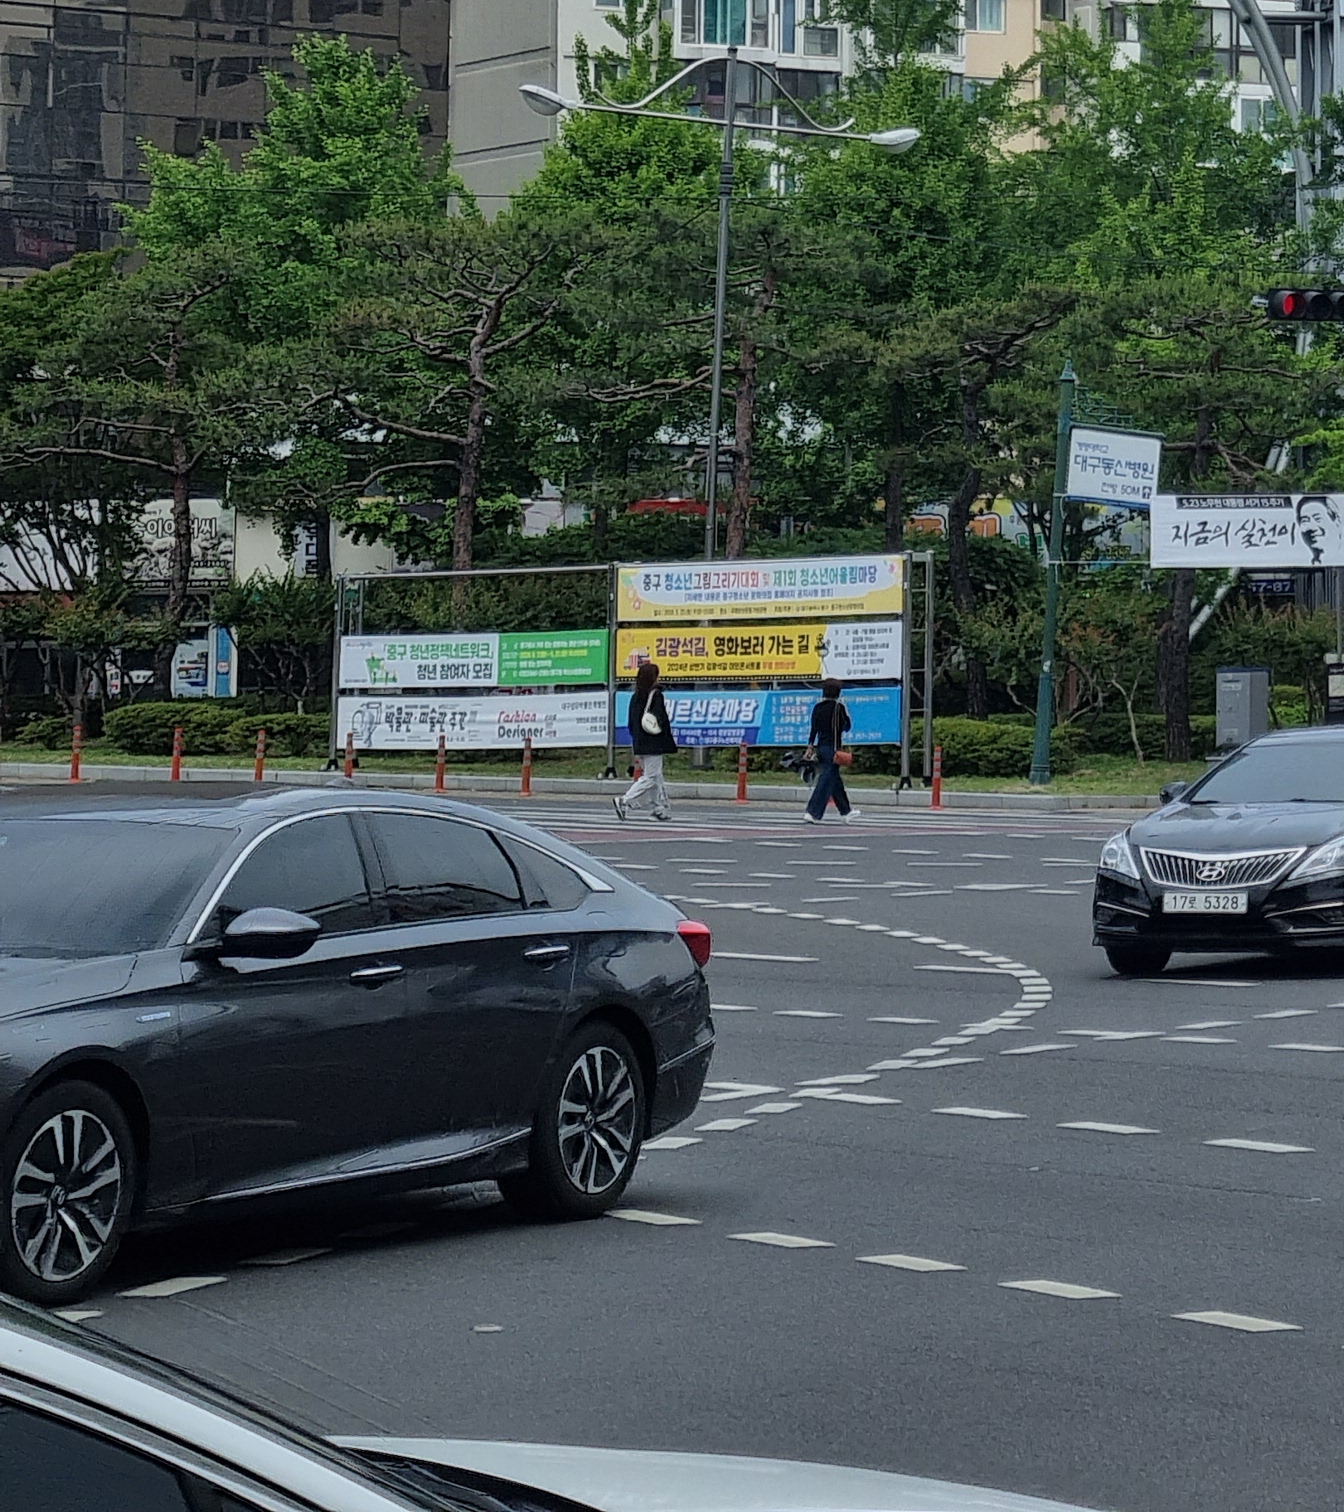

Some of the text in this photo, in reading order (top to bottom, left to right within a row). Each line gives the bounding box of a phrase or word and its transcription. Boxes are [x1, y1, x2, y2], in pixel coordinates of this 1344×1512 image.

[1074, 455, 1154, 480] 대구동산병원
[1120, 484, 1140, 495] 50M
[1200, 498, 1222, 508] 노무현
[1223, 498, 1244, 507] 대통령
[1245, 498, 1260, 508] 서거
[1172, 518, 1296, 549] 지금의 실천이
[643, 574, 661, 591] 중구
[664, 571, 759, 591] 청소년그림그리기대회
[773, 569, 797, 587] 제1회
[800, 565, 877, 587] 청소년어울림마당
[655, 637, 708, 658] 김광석길,
[713, 635, 765, 657] 영화보러
[768, 635, 793, 655] 가는
[797, 634, 810, 654] 길
[417, 663, 493, 681] 청년 참여자 모집
[498, 710, 537, 724] Fashion
[498, 725, 544, 740] Designer
[1203, 896, 1239, 909] 5328
